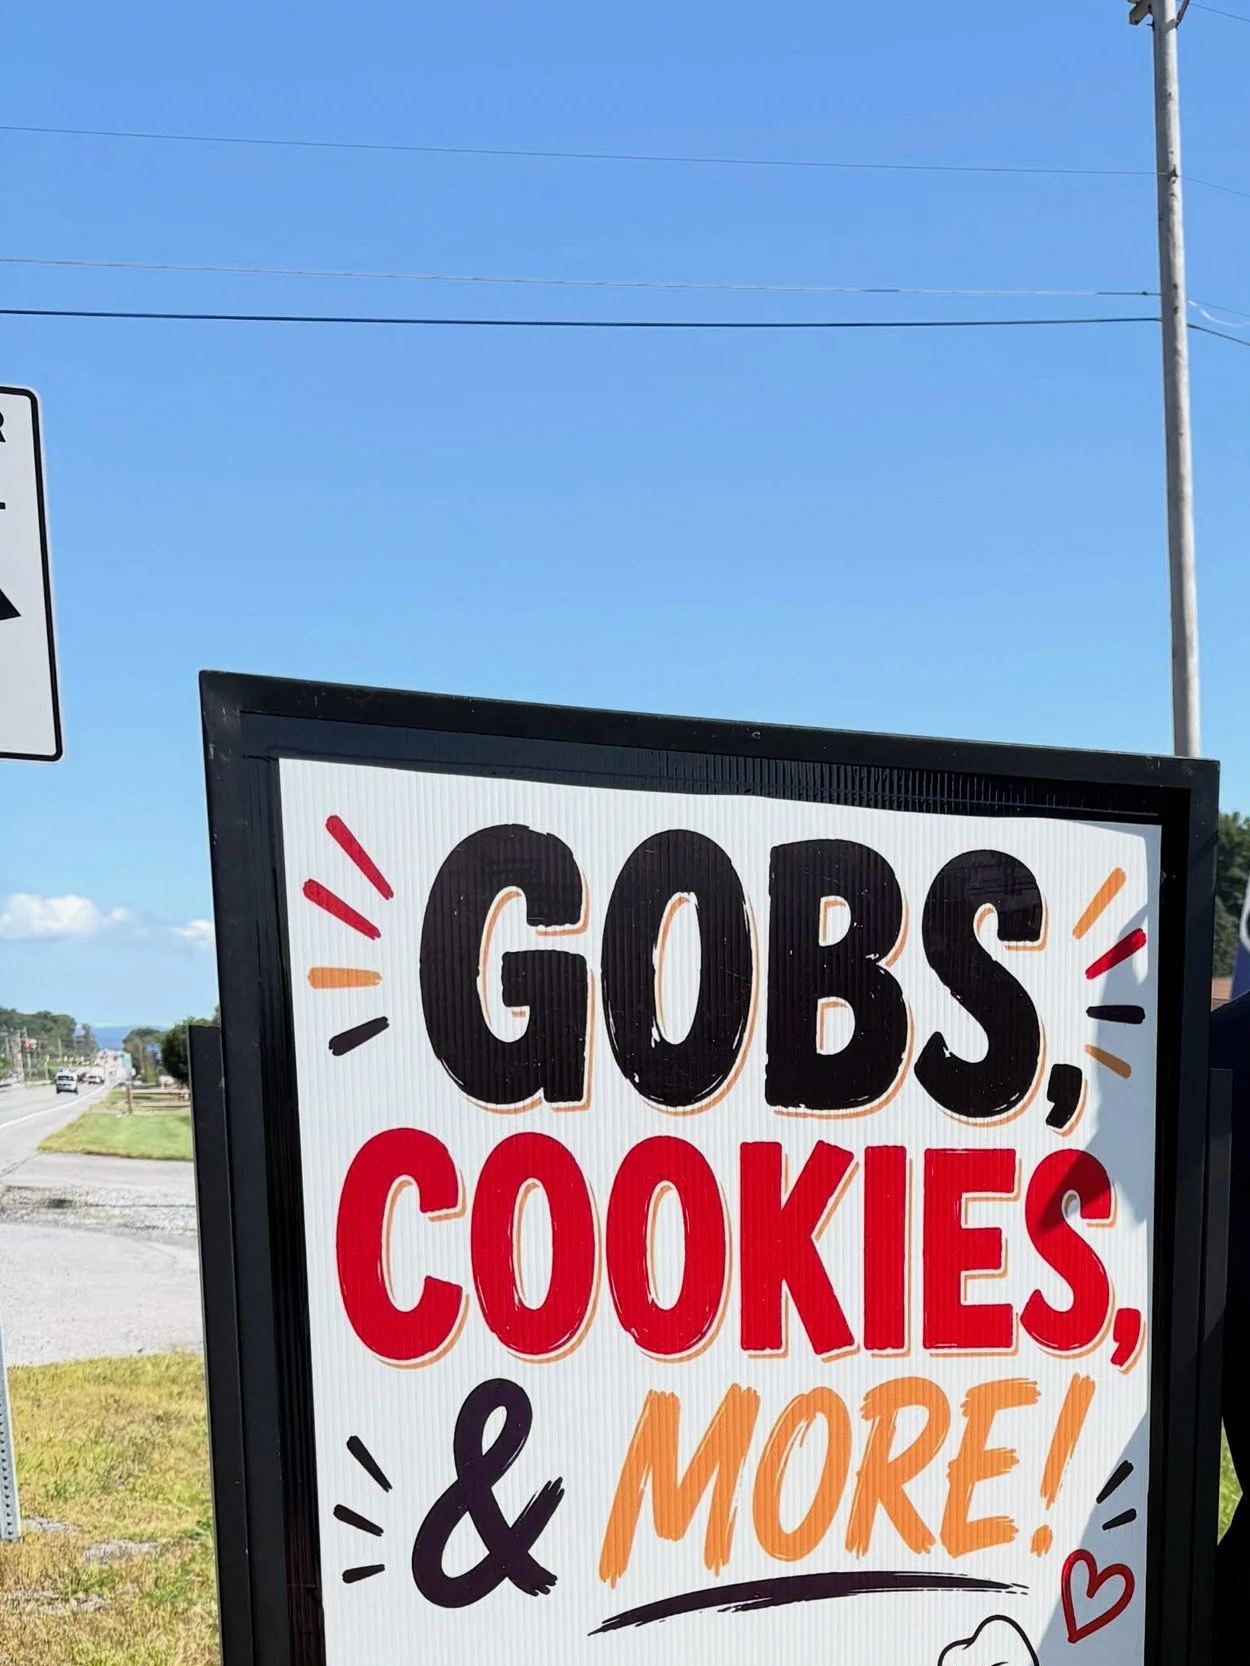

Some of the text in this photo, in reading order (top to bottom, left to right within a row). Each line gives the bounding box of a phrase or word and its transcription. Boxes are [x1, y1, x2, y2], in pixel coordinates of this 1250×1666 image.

[419, 823, 1087, 1134] GOBS,
[335, 1127, 1145, 1371] COOKIES,
[411, 1373, 1096, 1609] & MORE!
